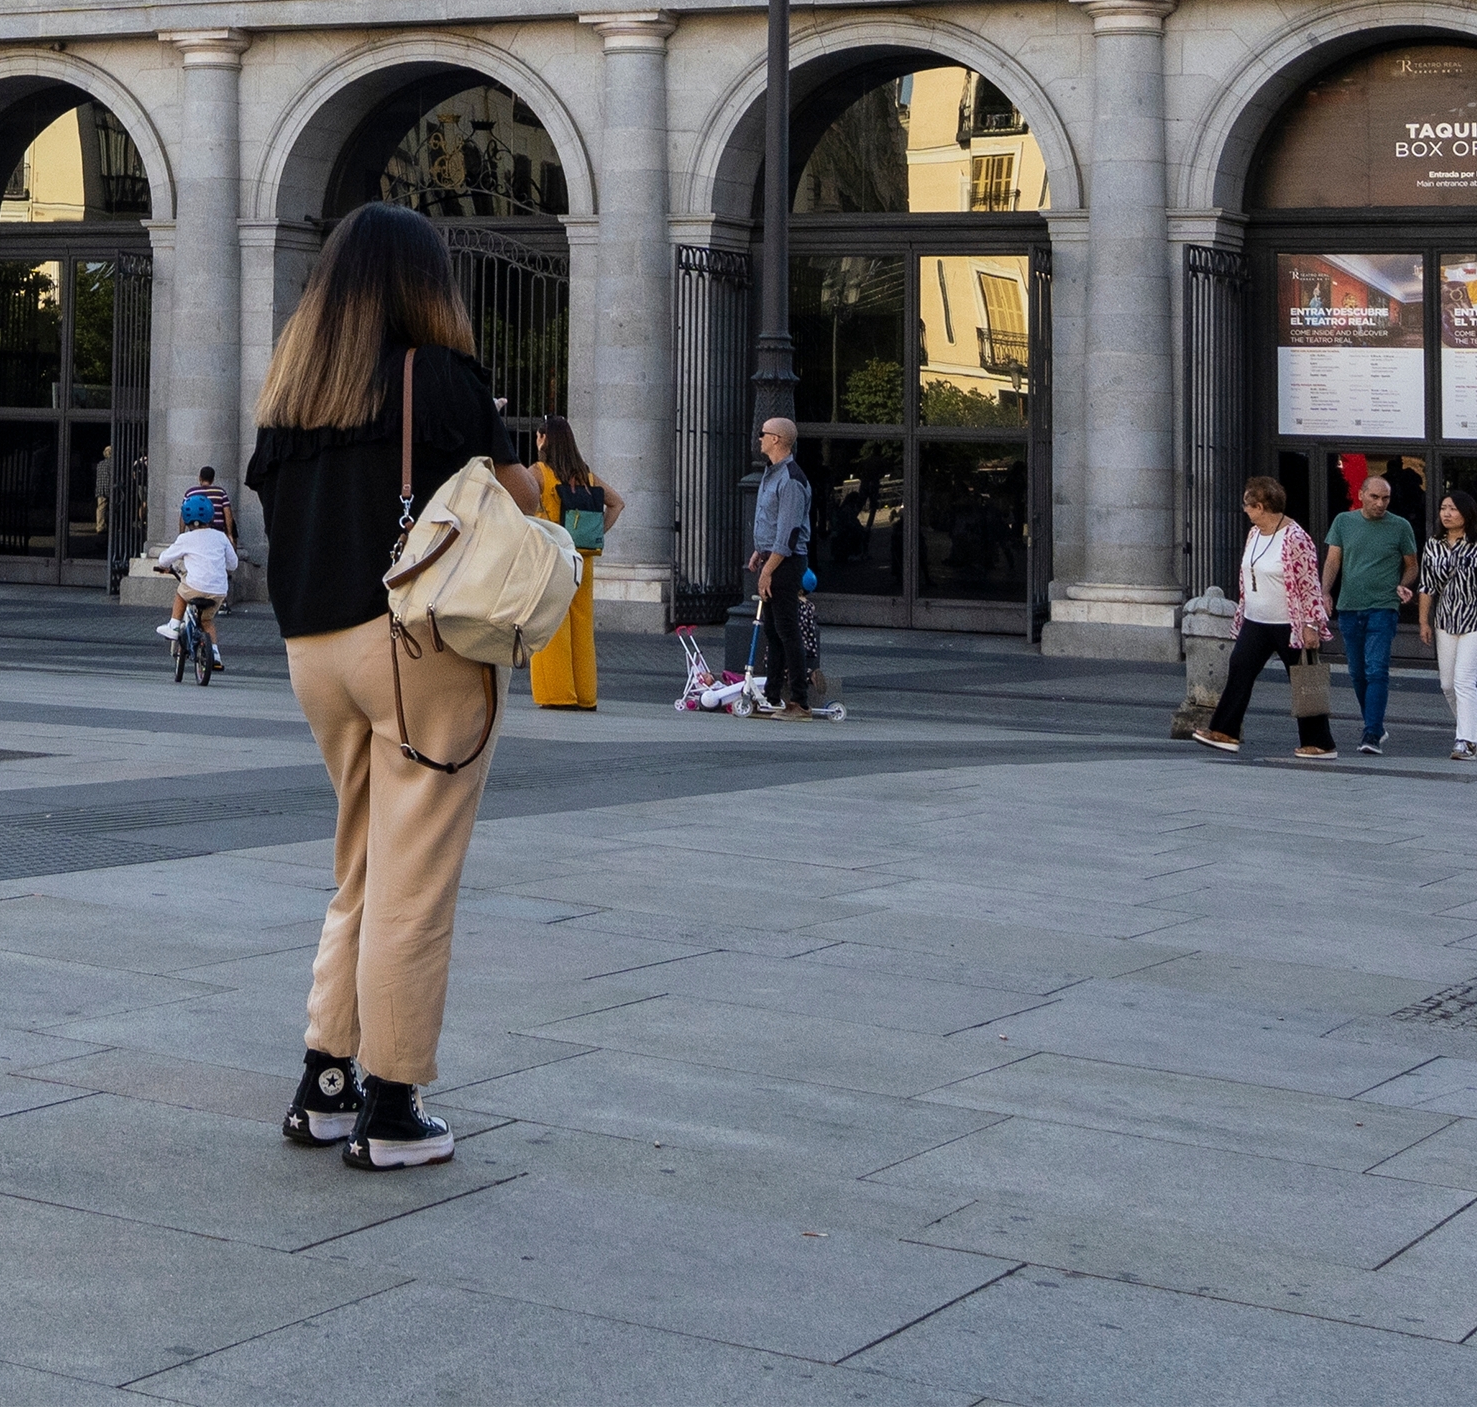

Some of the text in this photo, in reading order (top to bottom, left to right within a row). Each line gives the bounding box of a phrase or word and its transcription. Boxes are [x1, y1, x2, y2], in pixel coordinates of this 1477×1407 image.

[1395, 141, 1443, 157] BOX
[1429, 170, 1459, 178] Entrada
[1460, 171, 1474, 179] por
[1416, 179, 1434, 187] Main
[1290, 317, 1376, 326] EL TEATRO REAL
[1454, 317, 1467, 326] EL
